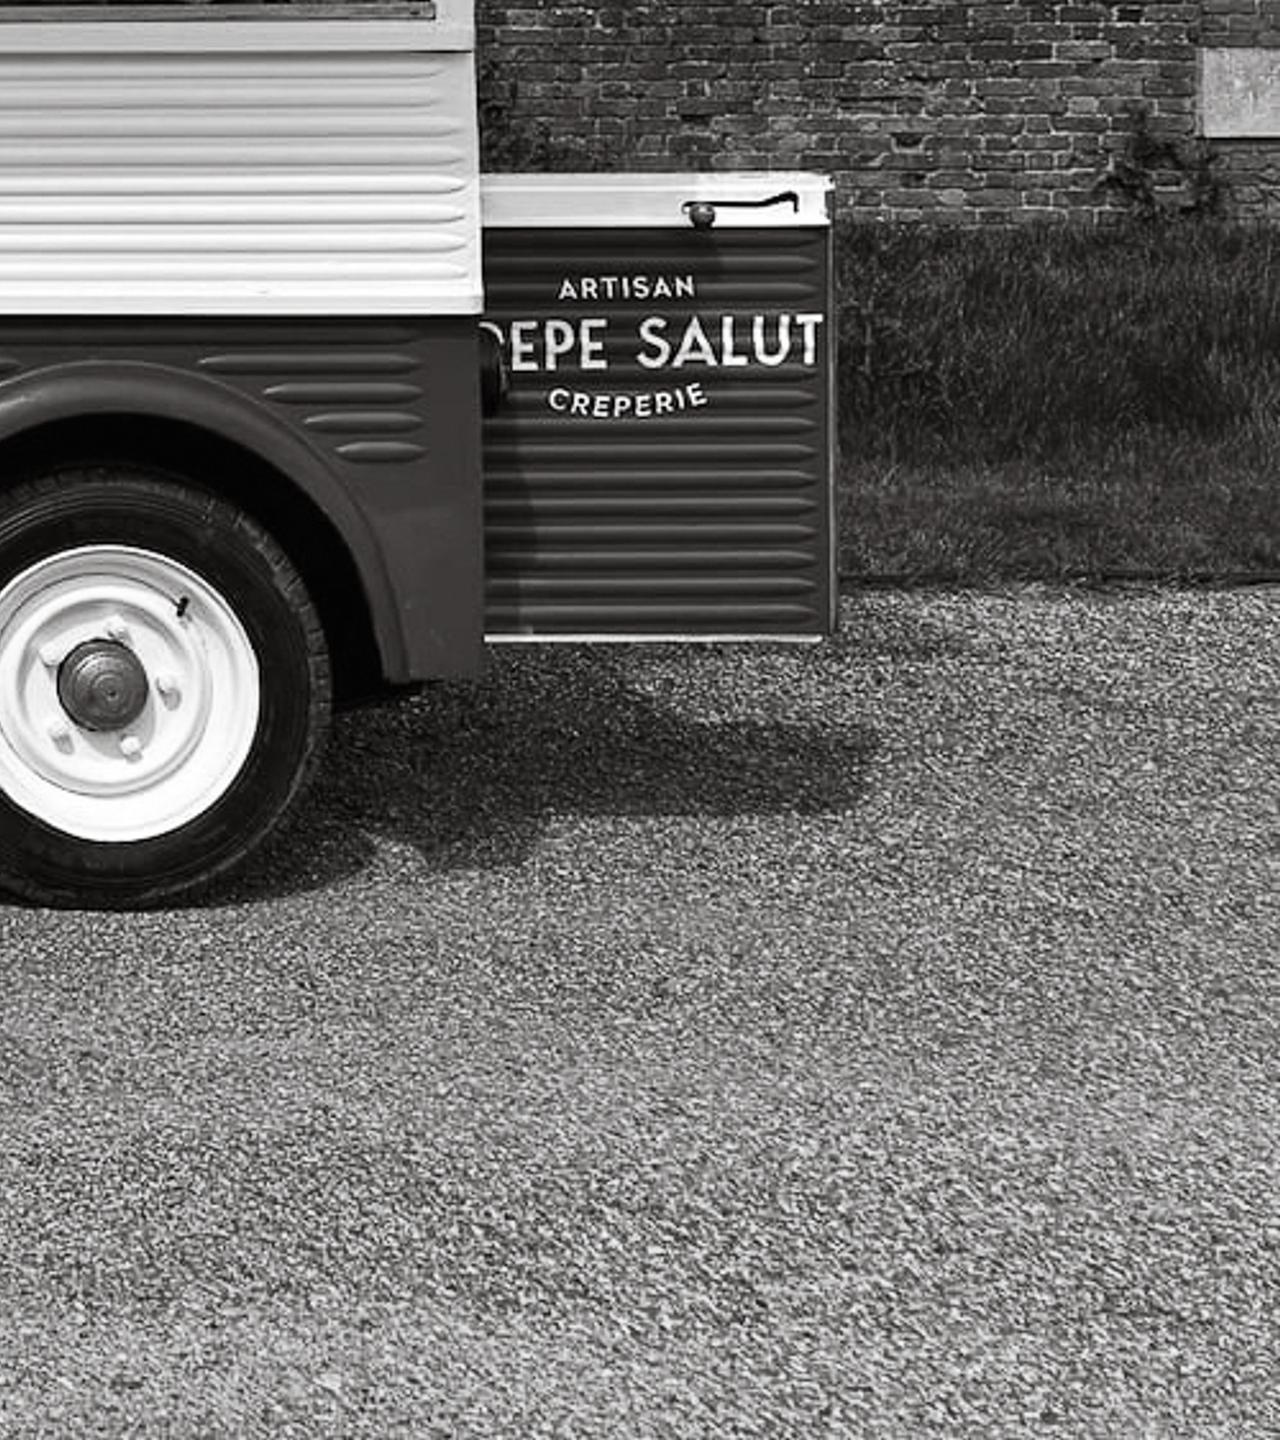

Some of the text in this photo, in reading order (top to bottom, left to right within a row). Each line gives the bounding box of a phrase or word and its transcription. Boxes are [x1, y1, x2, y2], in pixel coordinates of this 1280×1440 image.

[560, 277, 693, 298] ARTISAN
[477, 314, 823, 372] EPE SALUT
[550, 383, 706, 416] CREPERIE
